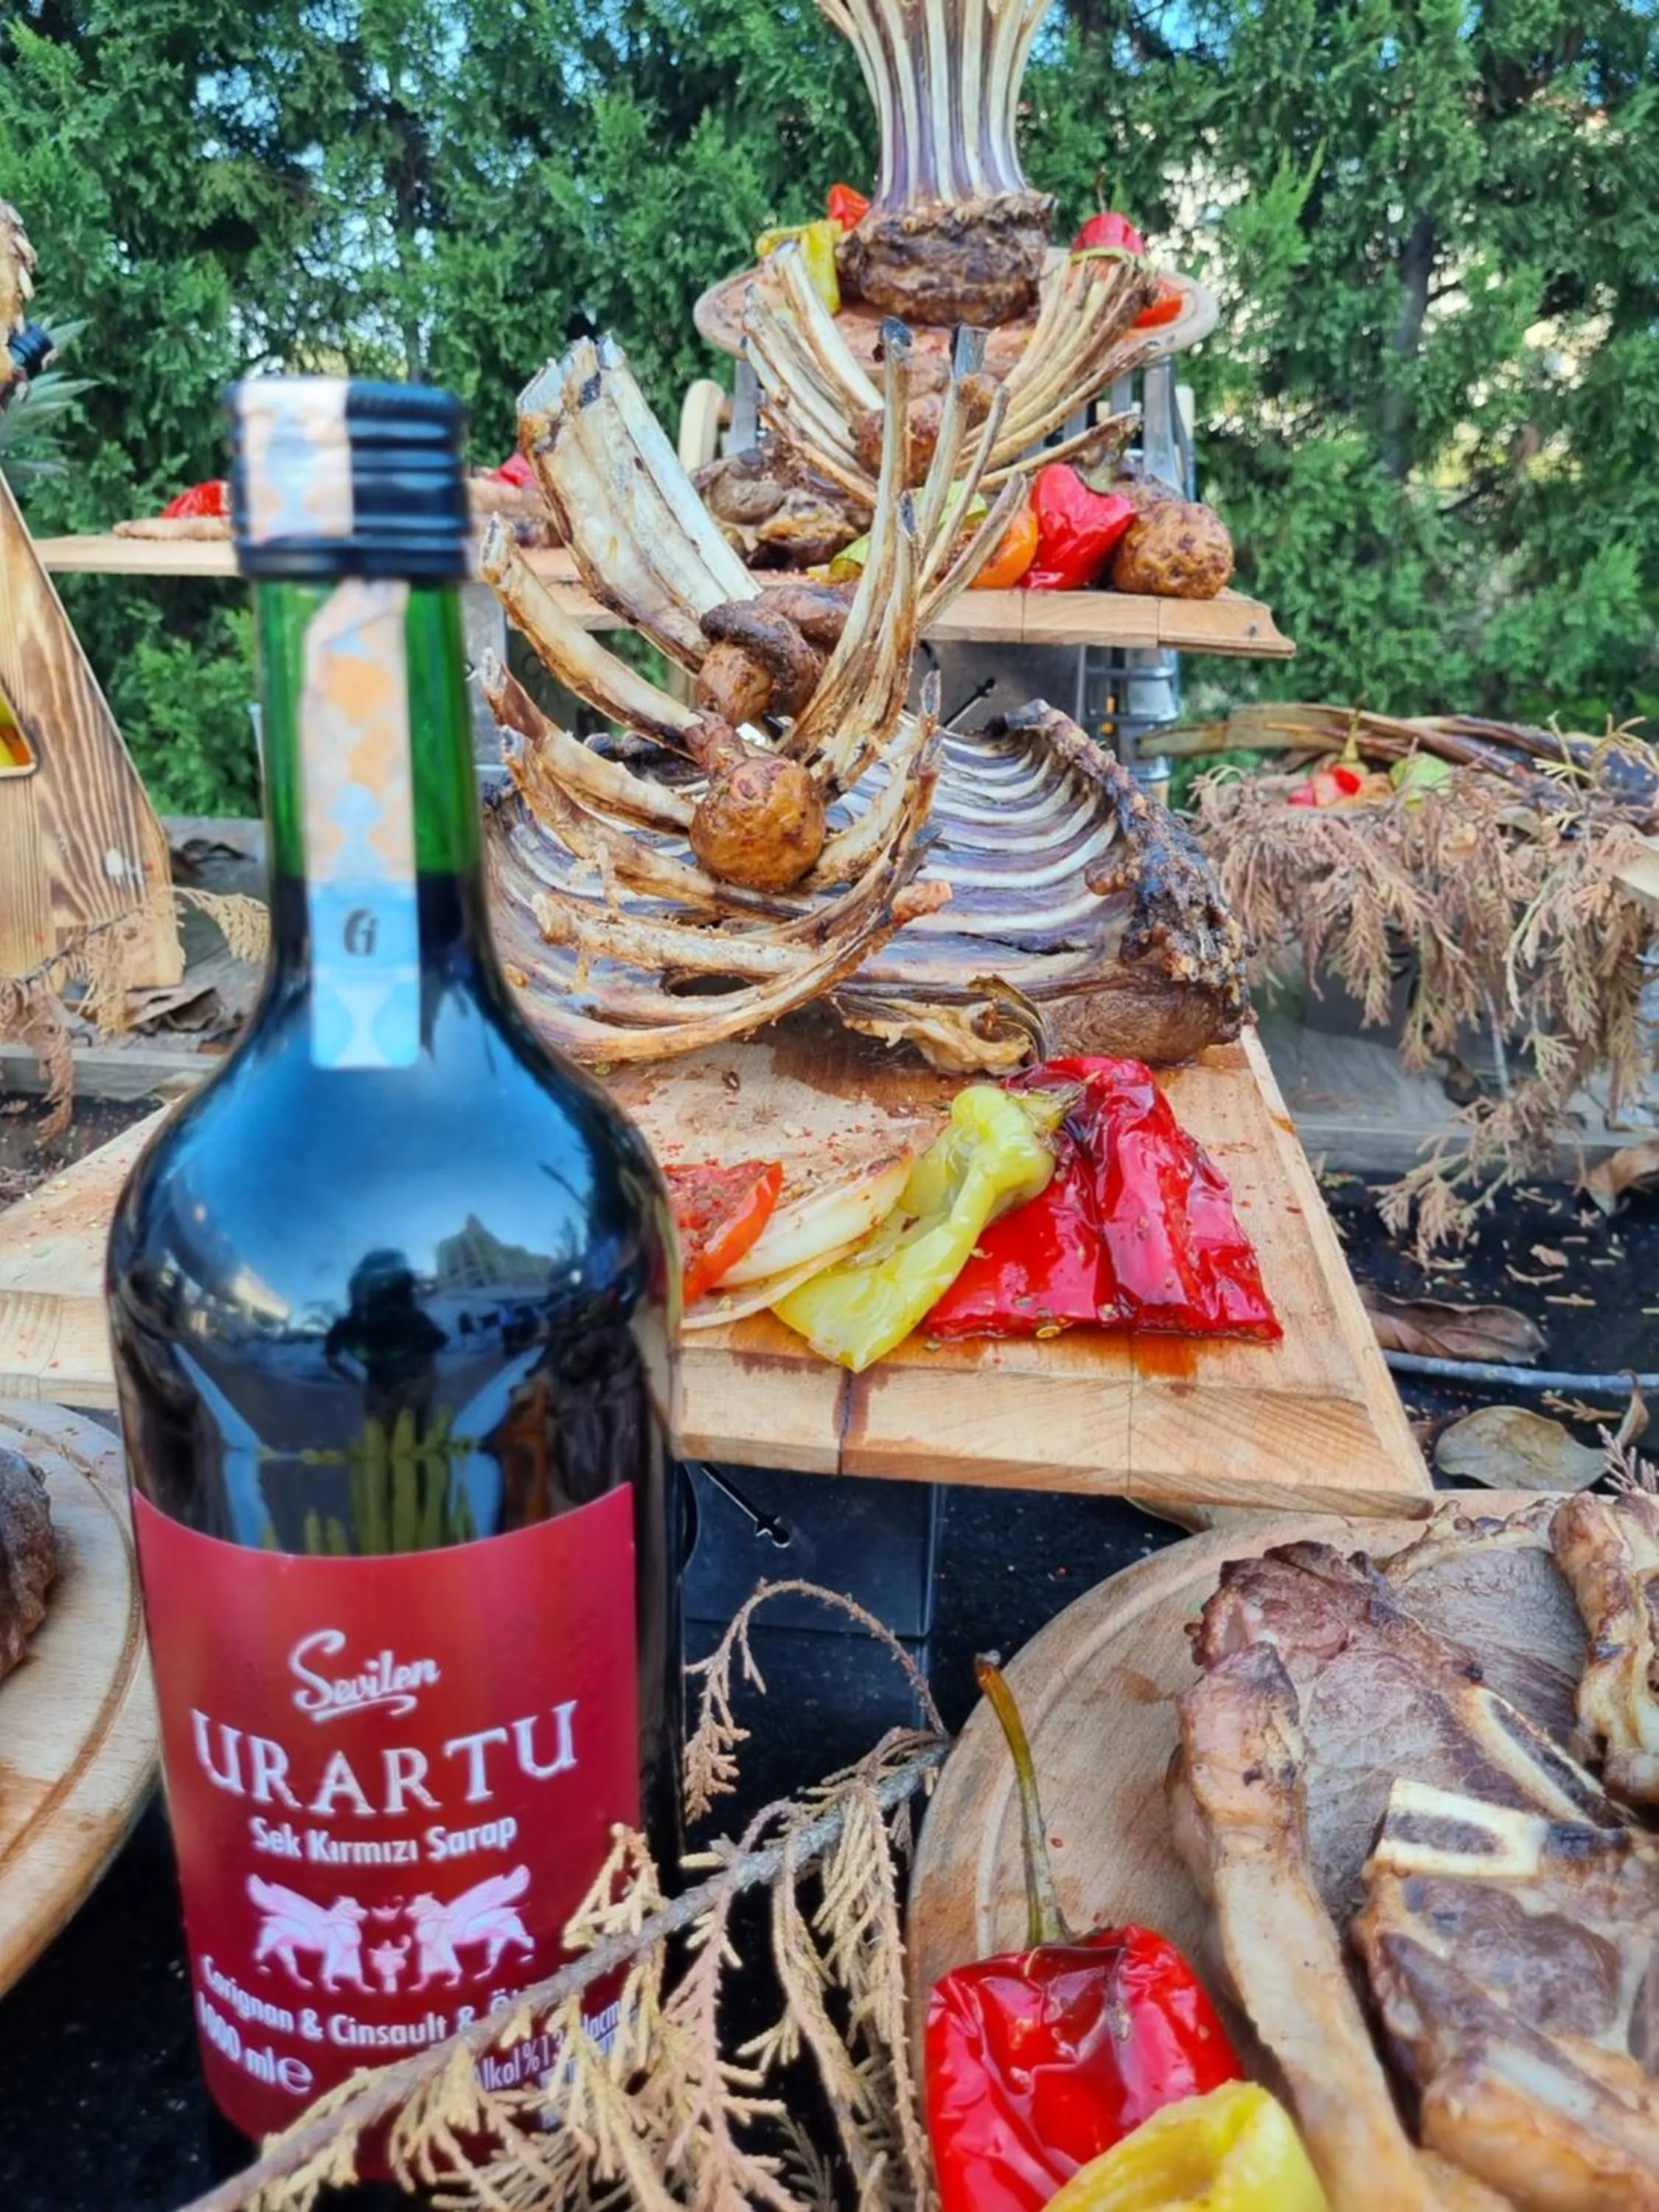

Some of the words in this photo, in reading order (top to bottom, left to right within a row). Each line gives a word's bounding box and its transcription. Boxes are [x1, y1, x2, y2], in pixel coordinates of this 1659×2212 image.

[288, 1629, 441, 1722] Sevilen
[191, 1700, 579, 1817] URARTU
[249, 1816, 302, 1860] Sek
[301, 2008, 324, 2041] &
[330, 2011, 447, 2046] Cinsault
